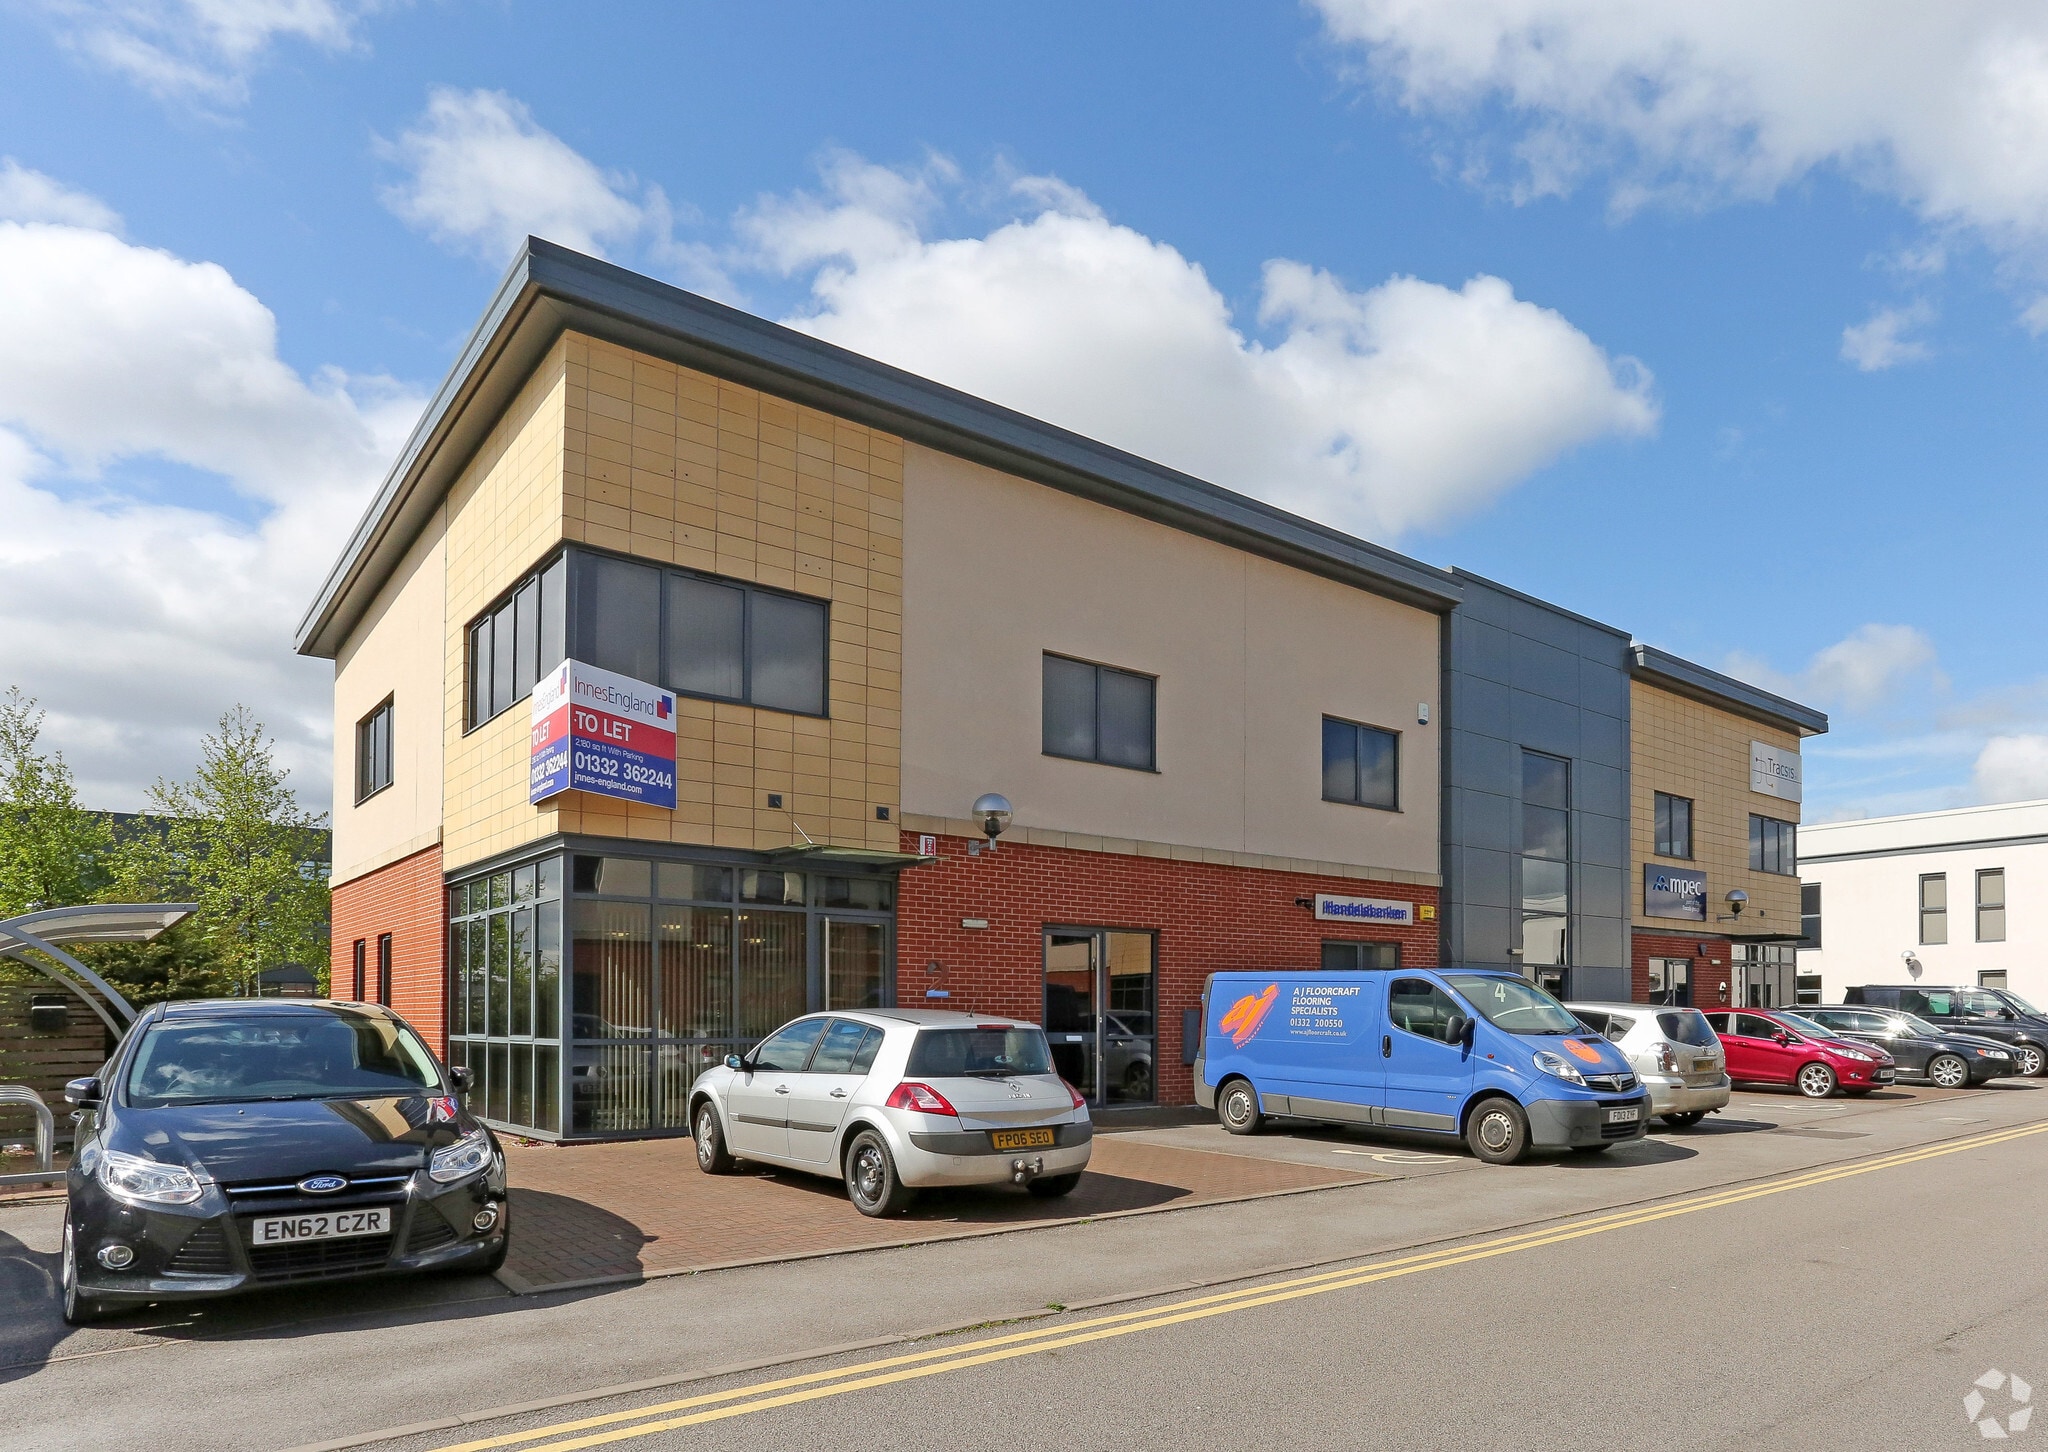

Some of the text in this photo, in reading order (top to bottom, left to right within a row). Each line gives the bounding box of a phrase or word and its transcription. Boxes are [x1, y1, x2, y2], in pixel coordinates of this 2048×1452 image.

[574, 676, 654, 716] InnesEngland
[539, 720, 550, 743] LET
[575, 710, 632, 741] TO LET
[607, 745, 622, 756] With
[622, 750, 644, 764] Parking
[575, 751, 618, 777] 01332
[623, 762, 673, 789] 362244
[1767, 757, 1795, 779] Tracsis
[574, 771, 643, 794] innes-england.com
[1669, 878, 1701, 899] mpec
[1292, 997, 1332, 1006] FLOORING
[1293, 987, 1361, 998] A J FLOORCRAFT
[1494, 982, 1506, 1003] 4
[1291, 1006, 1338, 1016] SPECIALISTS
[1290, 1018, 1343, 1028] 01332 200550
[998, 1133, 1028, 1147] FP06
[310, 1178, 336, 1190] Ford
[264, 1211, 381, 1241] EN62 CZR
